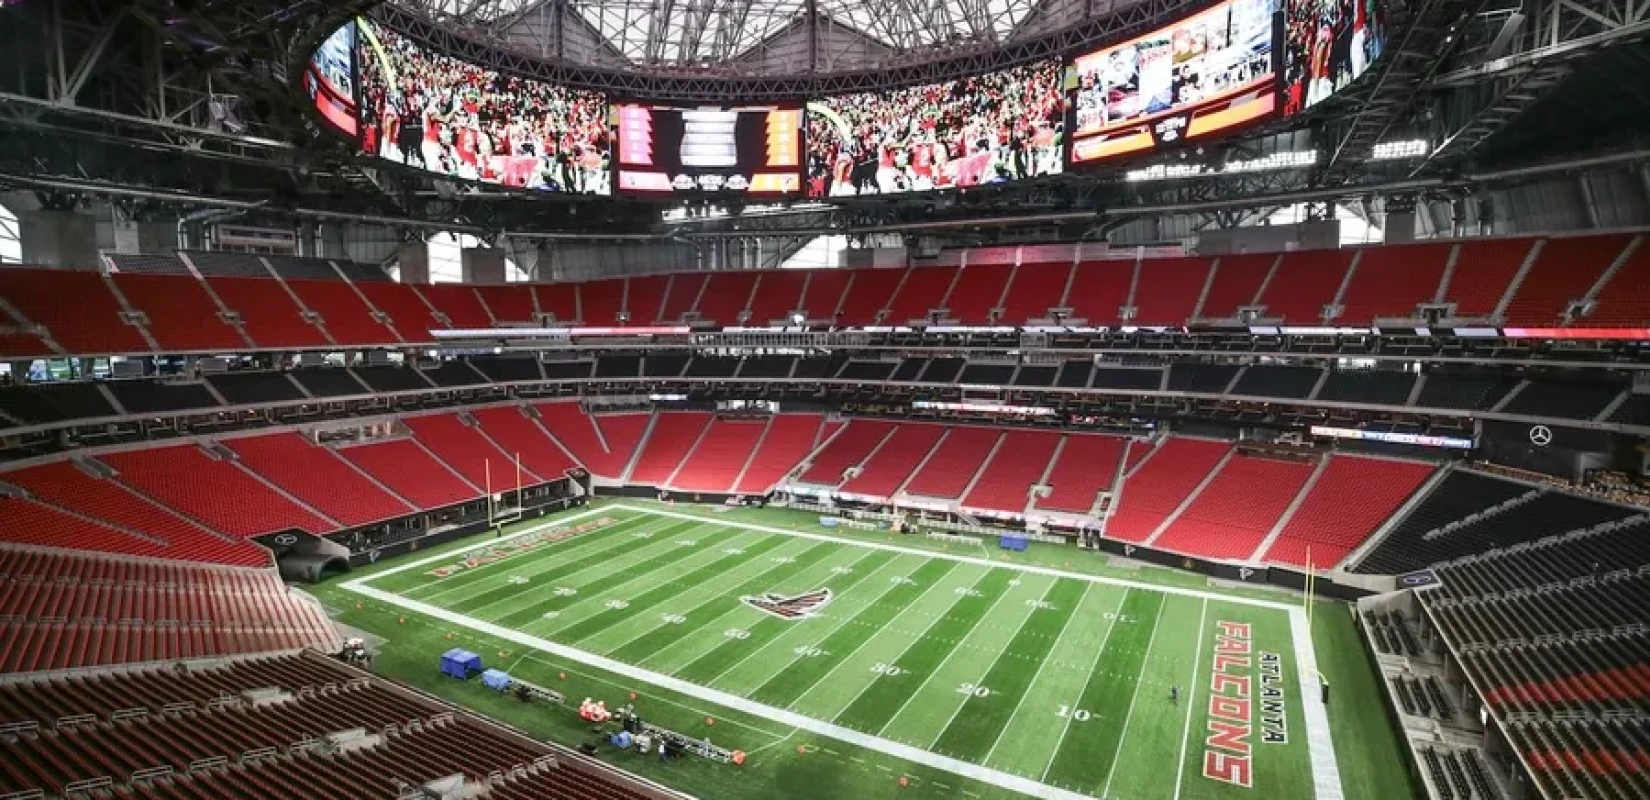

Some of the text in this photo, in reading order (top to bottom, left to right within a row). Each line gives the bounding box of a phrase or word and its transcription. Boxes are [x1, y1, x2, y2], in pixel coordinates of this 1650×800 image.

[956, 682, 990, 698] 20
[1055, 703, 1091, 722] 10
[1203, 620, 1253, 788] FALCONS
[1258, 651, 1288, 744] ATLANTA
